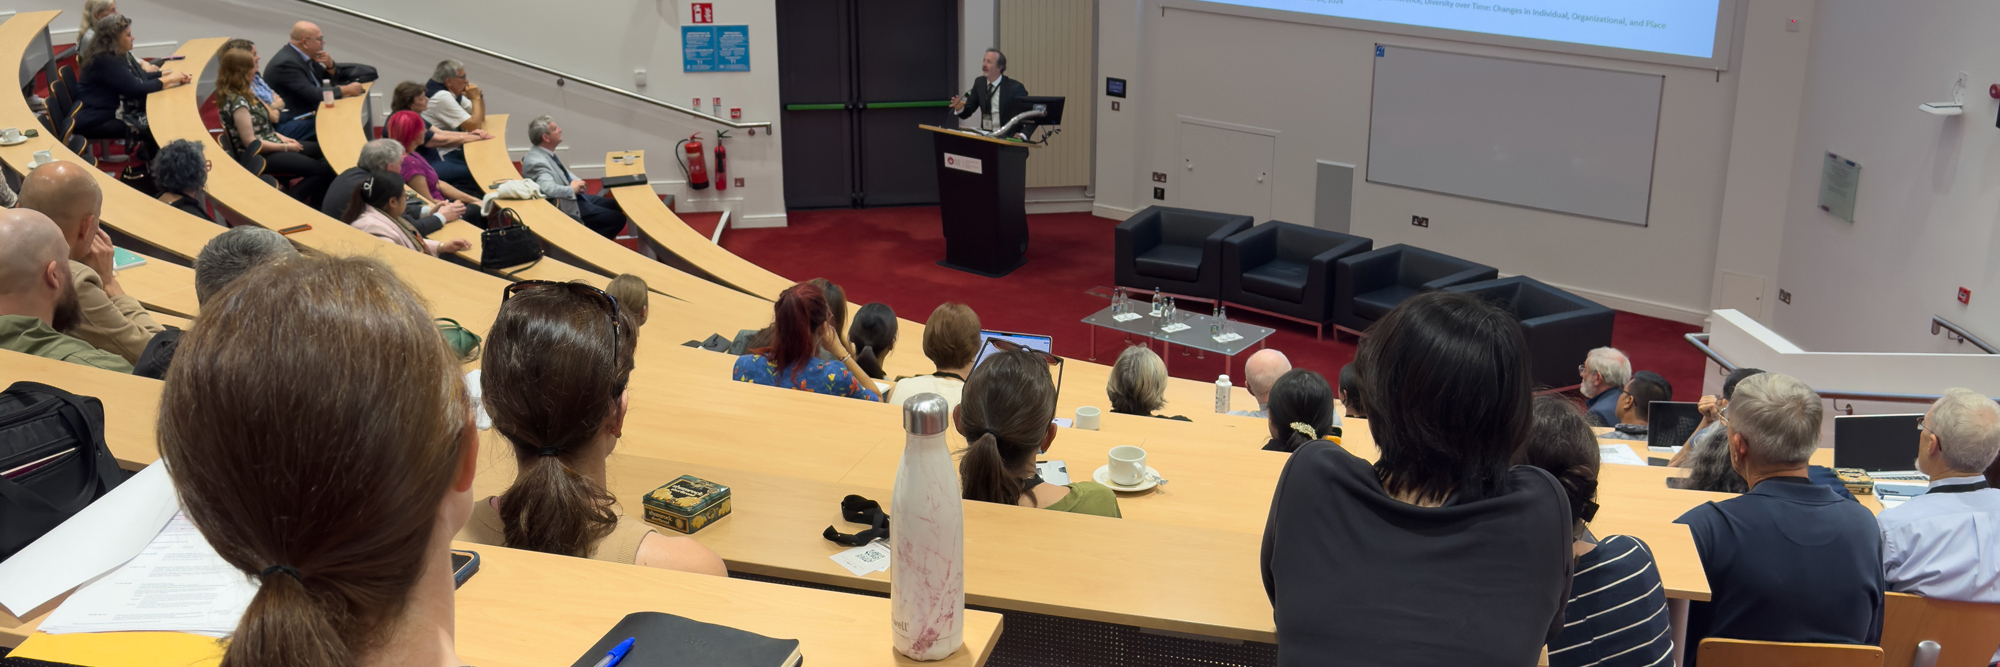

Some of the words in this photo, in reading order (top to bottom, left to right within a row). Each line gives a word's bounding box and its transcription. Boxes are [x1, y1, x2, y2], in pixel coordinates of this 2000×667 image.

[1425, 0, 1454, 8] Diversity
[1472, 2, 1492, 11] Time:
[1493, 4, 1522, 16] Changes
[1532, 8, 1570, 20] Individual,
[1571, 12, 1627, 26] Organizational,
[1629, 18, 1645, 27] and
